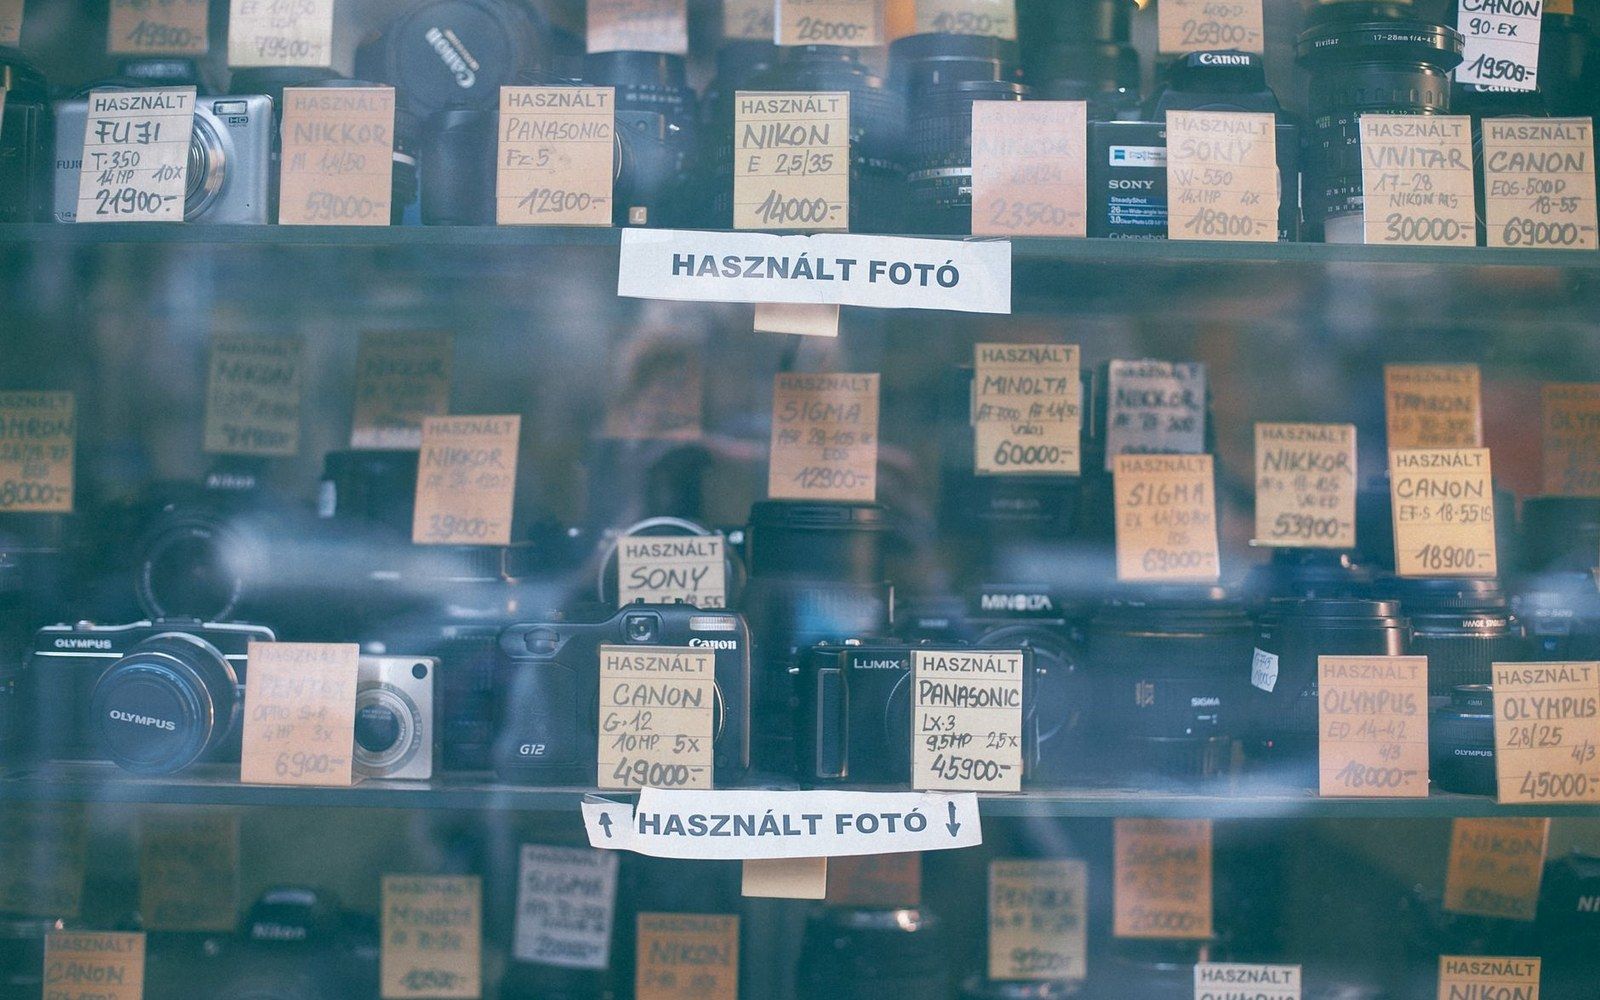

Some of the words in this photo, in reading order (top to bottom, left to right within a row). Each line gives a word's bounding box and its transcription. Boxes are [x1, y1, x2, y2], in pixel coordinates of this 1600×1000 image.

[1464, 0, 1539, 18] CANON
[1199, 52, 1251, 66] Canon
[95, 93, 188, 112] HASZNÁLT
[507, 91, 608, 109] HASZNÁLT
[741, 95, 840, 114] HASZNÁLT
[95, 121, 161, 145] FUJI
[293, 121, 390, 148] NIKKOR
[506, 116, 611, 142] PANASONIC
[1174, 116, 1269, 135] HASZNÁLT
[1366, 119, 1462, 138] HASZNÁLT
[1491, 123, 1588, 143] HASZNÁLT
[742, 122, 831, 149] NIKON
[1176, 139, 1253, 162] SONY
[1367, 144, 1471, 171] VIVITAR
[747, 155, 761, 173] E
[1487, 150, 1585, 175] CANON
[1108, 179, 1155, 191] SONY
[671, 252, 857, 282] HASZNÁLT
[868, 259, 961, 289] FOTÓ
[981, 348, 1073, 362] HASZNÁLT
[982, 375, 1067, 396] MINOLTA
[778, 400, 863, 424] SIGMA
[1120, 459, 1206, 474] HASZNÁLT
[1263, 448, 1353, 475] NIKKOR
[1395, 453, 1483, 468] HASZNÁLT
[1127, 481, 1206, 506] SIGMA
[1396, 478, 1483, 499] CANON
[627, 540, 719, 558] HASZNÁLT
[627, 565, 709, 590] SONY
[981, 593, 1053, 611] MINOLTA
[54, 638, 113, 650] OLYMPUS
[688, 637, 738, 650] Canon
[606, 656, 707, 673] HASZNÁLT
[853, 657, 900, 669] LUMIX
[922, 655, 1019, 674] HASZNÁLT
[1322, 664, 1419, 681] HASZNÁLT
[1497, 665, 1592, 685] HASZNÁLT
[613, 682, 702, 708] CANON
[919, 679, 1020, 708] PANASONIC
[1323, 688, 1418, 717] OLYMPUS
[1503, 696, 1598, 721] OLYMPUS
[109, 709, 177, 732] OLYMPUS
[519, 743, 546, 757] G12
[1454, 748, 1493, 758] OLYMPUS
[1570, 738, 1596, 766] 4/3
[638, 807, 824, 837] HASZNÁLT
[835, 806, 928, 835] FOTÓ
[46, 962, 125, 985] CANON
[1201, 967, 1292, 983] HASZNÁLT
[1446, 960, 1535, 977] HASZNÁLT
